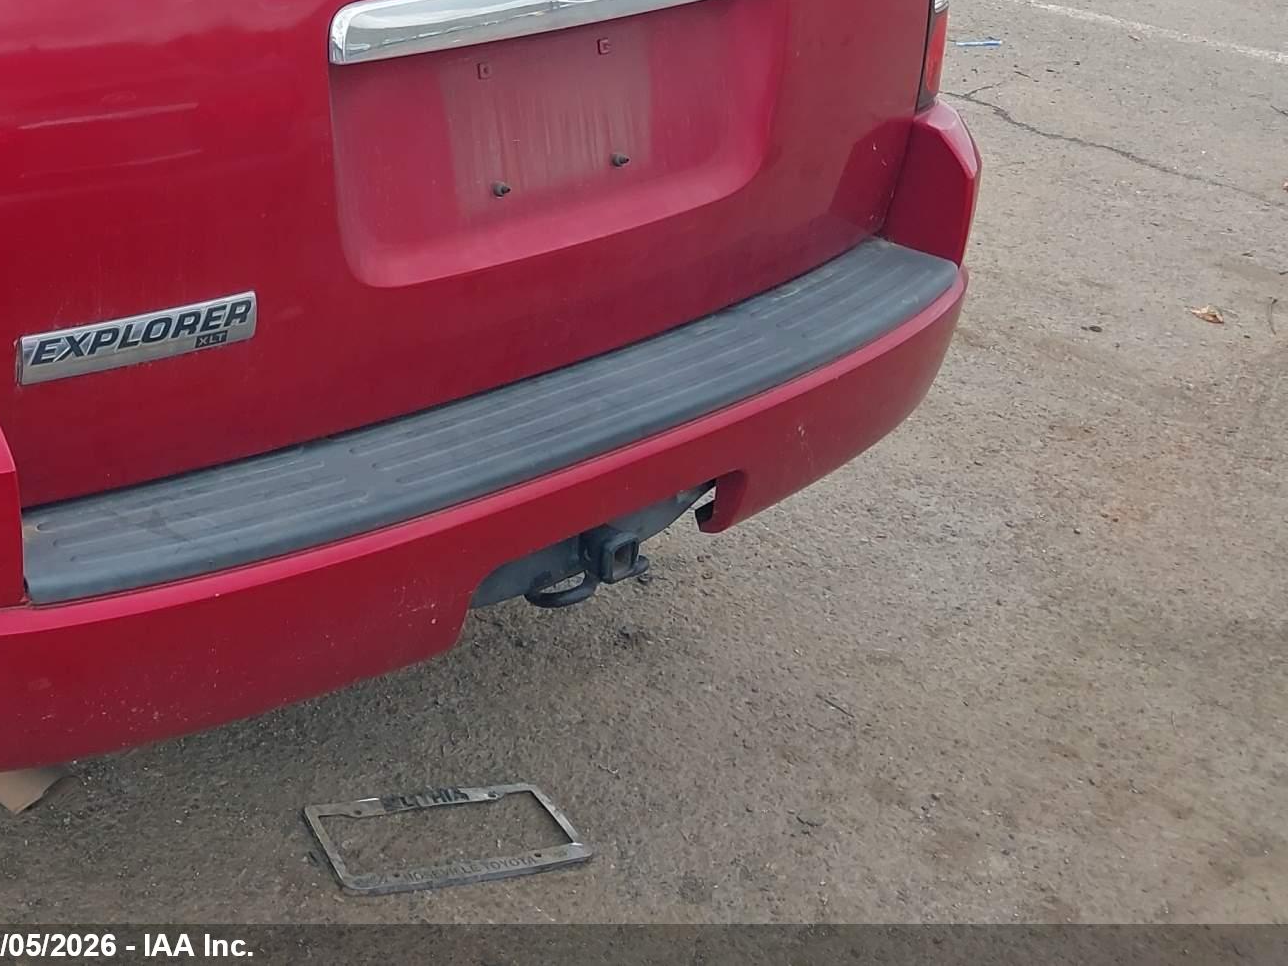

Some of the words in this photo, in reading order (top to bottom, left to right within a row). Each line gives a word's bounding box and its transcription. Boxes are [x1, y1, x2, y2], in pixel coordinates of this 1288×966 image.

[29, 299, 252, 366] EXPLORER
[198, 332, 226, 347] XLT
[484, 857, 538, 871] TOYOTA
